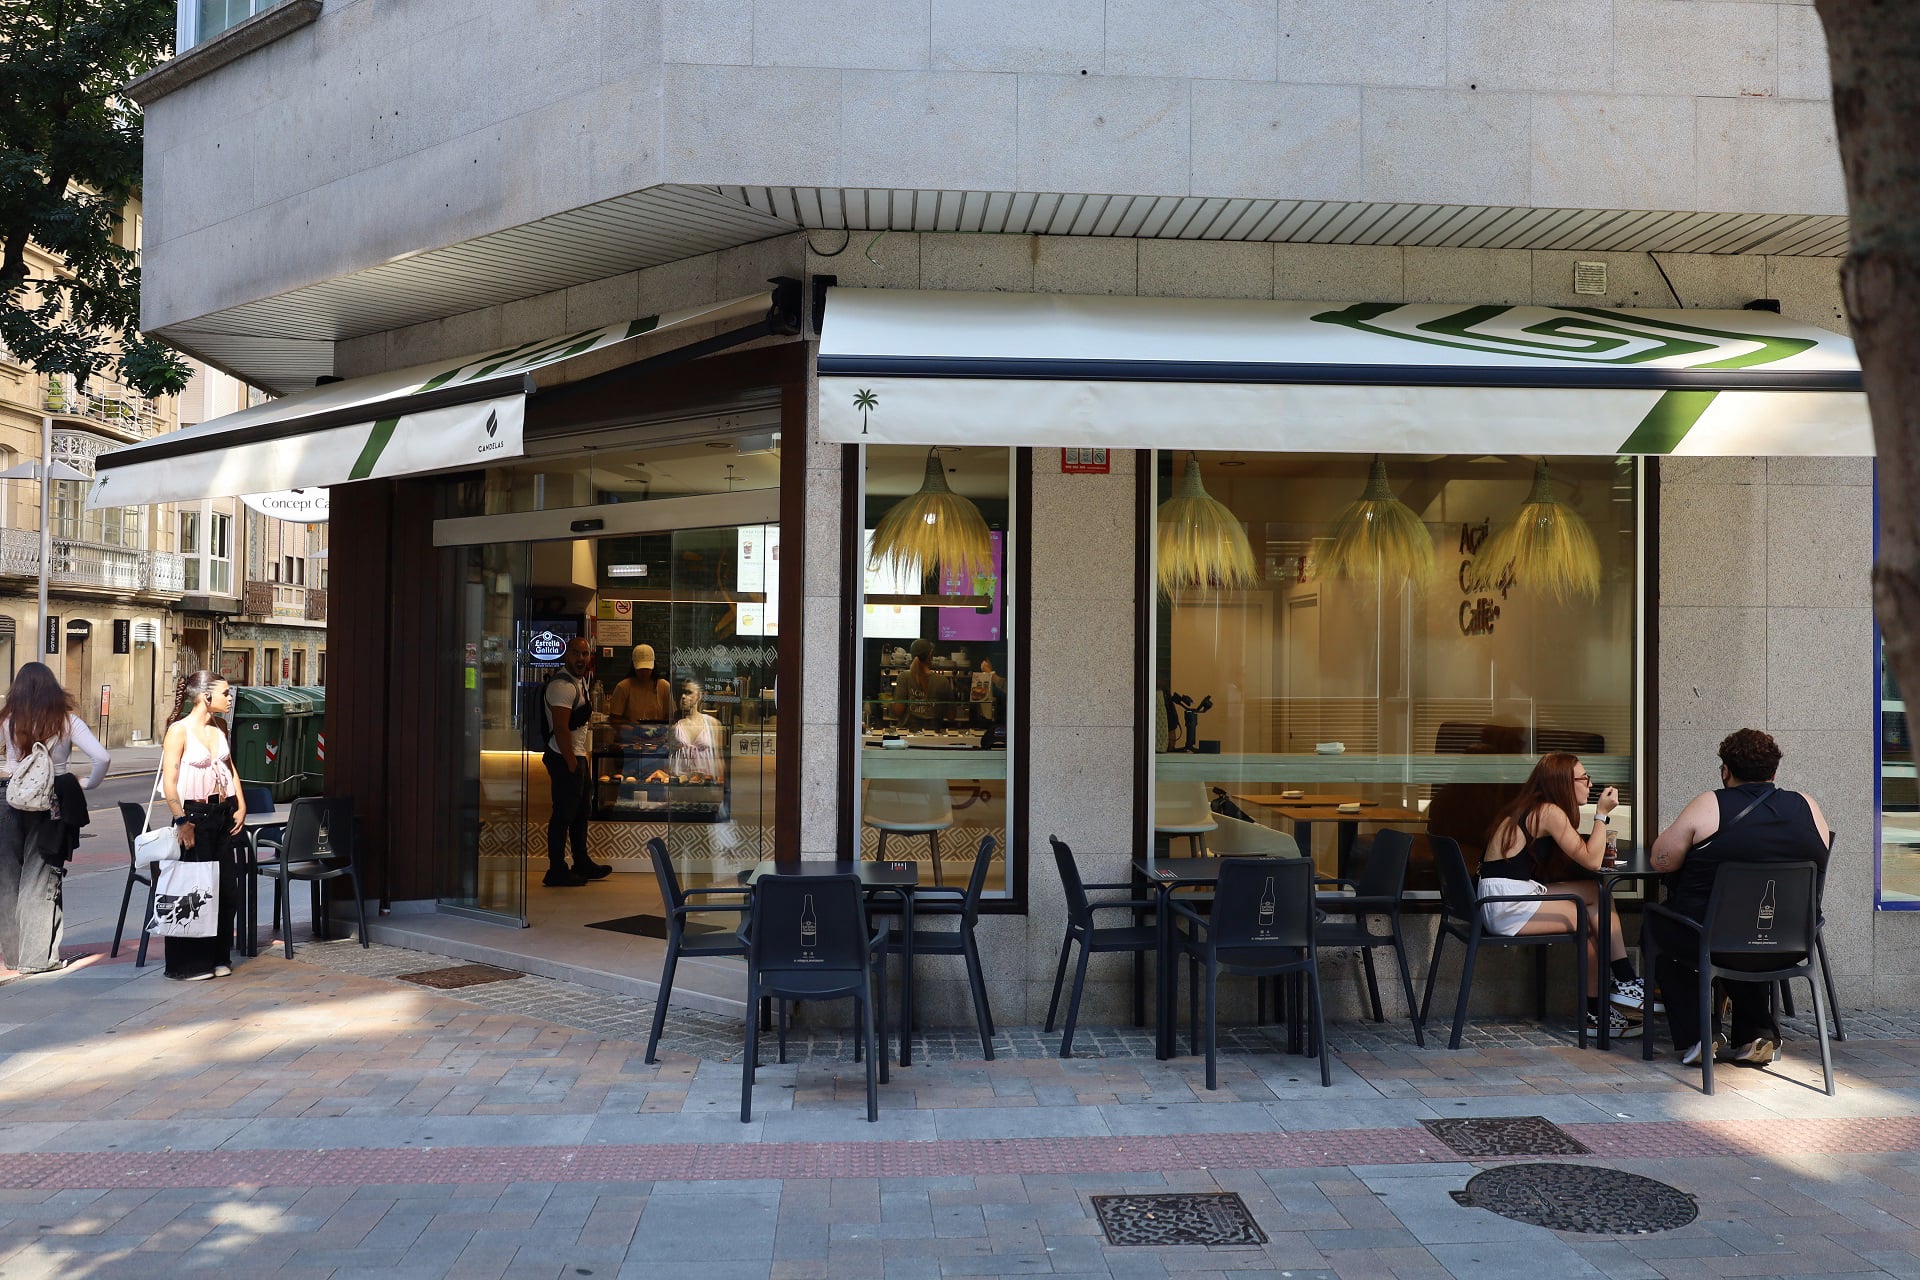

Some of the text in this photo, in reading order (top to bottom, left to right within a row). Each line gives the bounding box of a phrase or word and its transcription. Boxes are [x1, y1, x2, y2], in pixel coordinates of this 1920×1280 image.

[477, 441, 504, 453] CANDELAS
[262, 497, 329, 512] Concept Ca
[183, 618, 209, 629] DIFICIO
[534, 639, 560, 647] Estrella
[535, 646, 559, 654] Galicia
